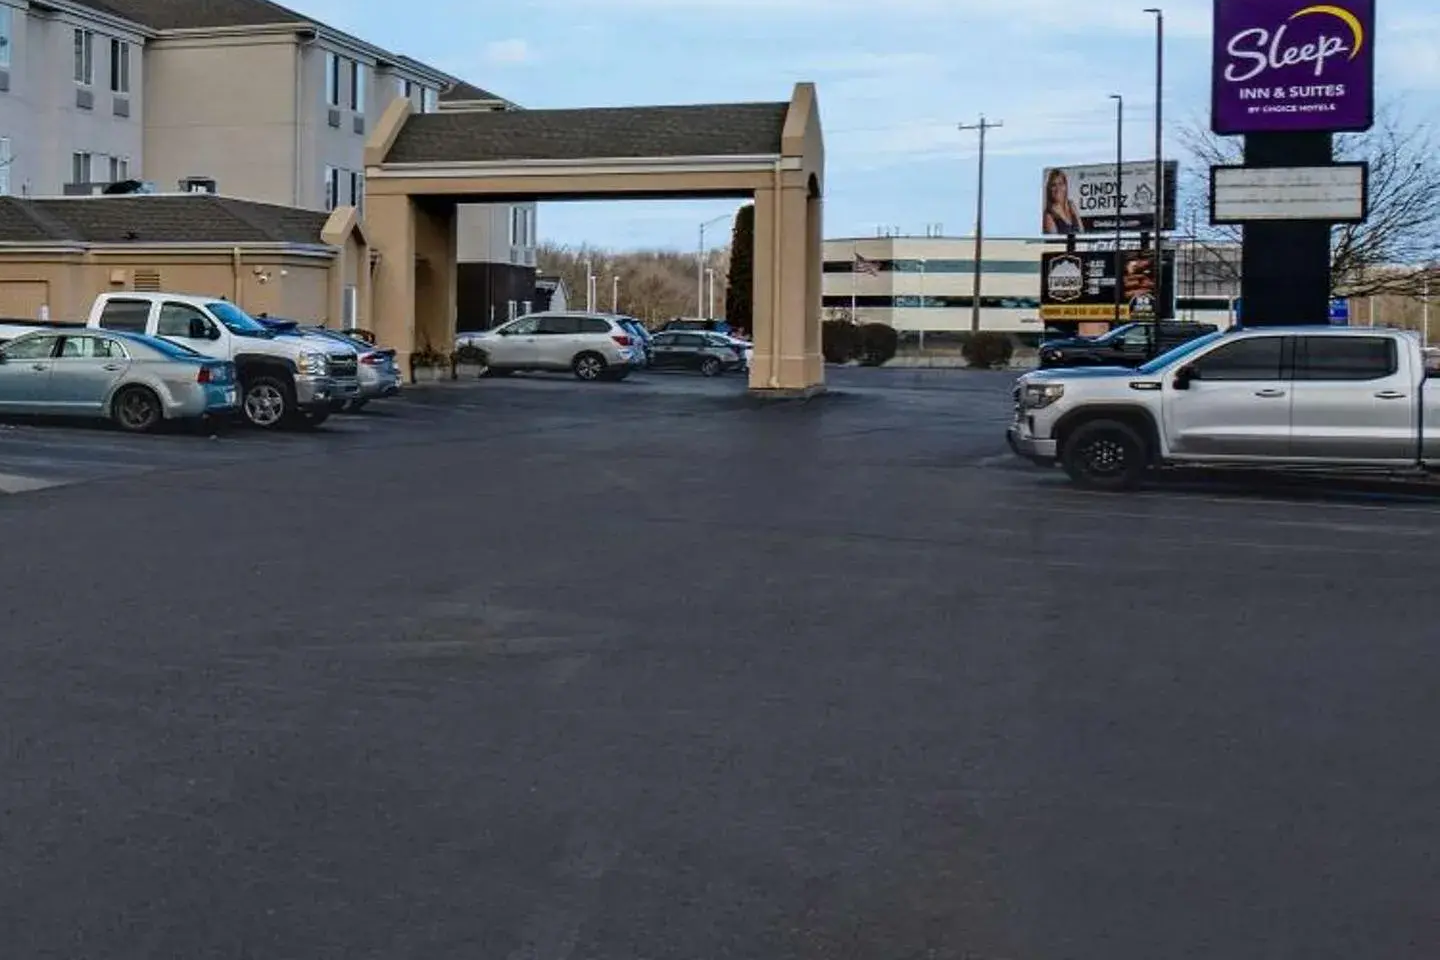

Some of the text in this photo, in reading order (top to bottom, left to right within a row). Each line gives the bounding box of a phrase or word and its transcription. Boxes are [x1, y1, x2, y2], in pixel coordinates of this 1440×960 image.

[1224, 24, 1350, 82] Sleep
[1240, 84, 1345, 100] INN & SUITES
[1080, 194, 1128, 210] LORITZ
